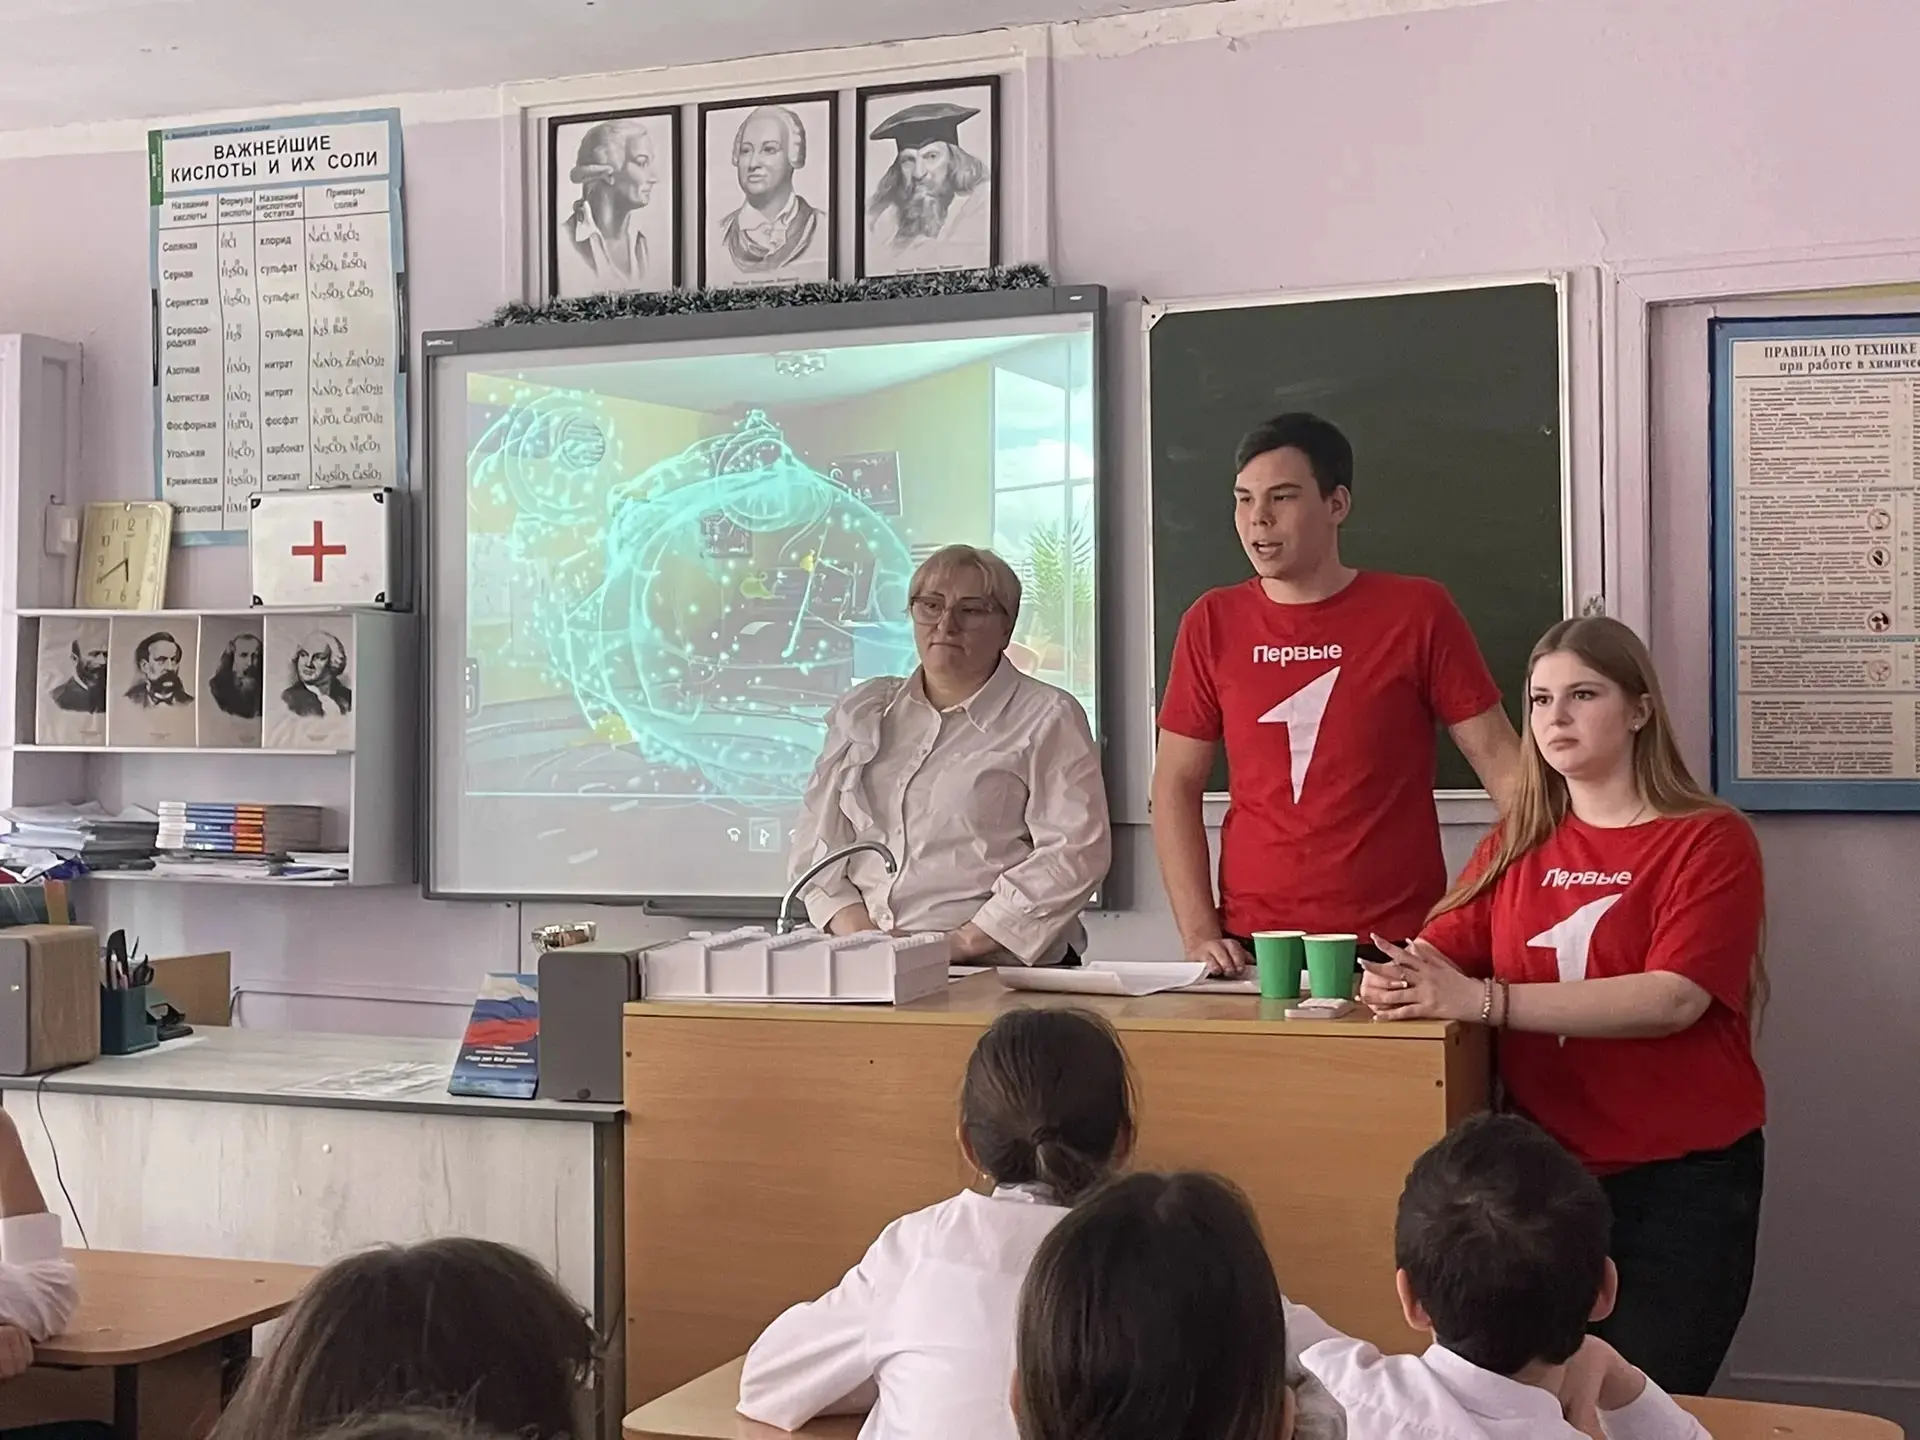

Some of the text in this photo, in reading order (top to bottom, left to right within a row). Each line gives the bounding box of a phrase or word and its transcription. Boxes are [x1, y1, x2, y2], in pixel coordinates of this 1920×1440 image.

[214, 135, 331, 159] ВАЖНЕЙШИЕ
[171, 151, 377, 182] КИСЛОТЫ И ИХ СОЛИ
[259, 193, 298, 202] Название
[326, 187, 365, 198] Примеры
[220, 197, 252, 208] Формула
[334, 199, 358, 209] солей
[173, 212, 207, 220] кислоты
[264, 209, 294, 218] остатка
[260, 237, 291, 246] хлорид
[261, 264, 297, 275] сульфат
[166, 297, 208, 308] Сернистая
[265, 327, 304, 338] сульфид
[1764, 343, 1917, 358] ПРАВИЛА ПО ТЕХНИКЕ
[166, 365, 200, 375] Азотная
[264, 361, 293, 370] нитрат
[1779, 362, 1803, 373] при
[1808, 359, 1852, 373] работе
[1858, 361, 1864, 369] в
[166, 393, 210, 402] Азотистая
[166, 421, 217, 431] Фосфорная
[265, 416, 298, 426] фосфат
[166, 449, 205, 458] Угольная
[267, 473, 300, 482] силикат
[173, 503, 222, 514] арганцовая
[127, 518, 135, 531] 12
[102, 534, 110, 547] 10
[120, 589, 127, 603] 6
[1253, 643, 1343, 666] Первые
[1542, 867, 1632, 888] Первые
